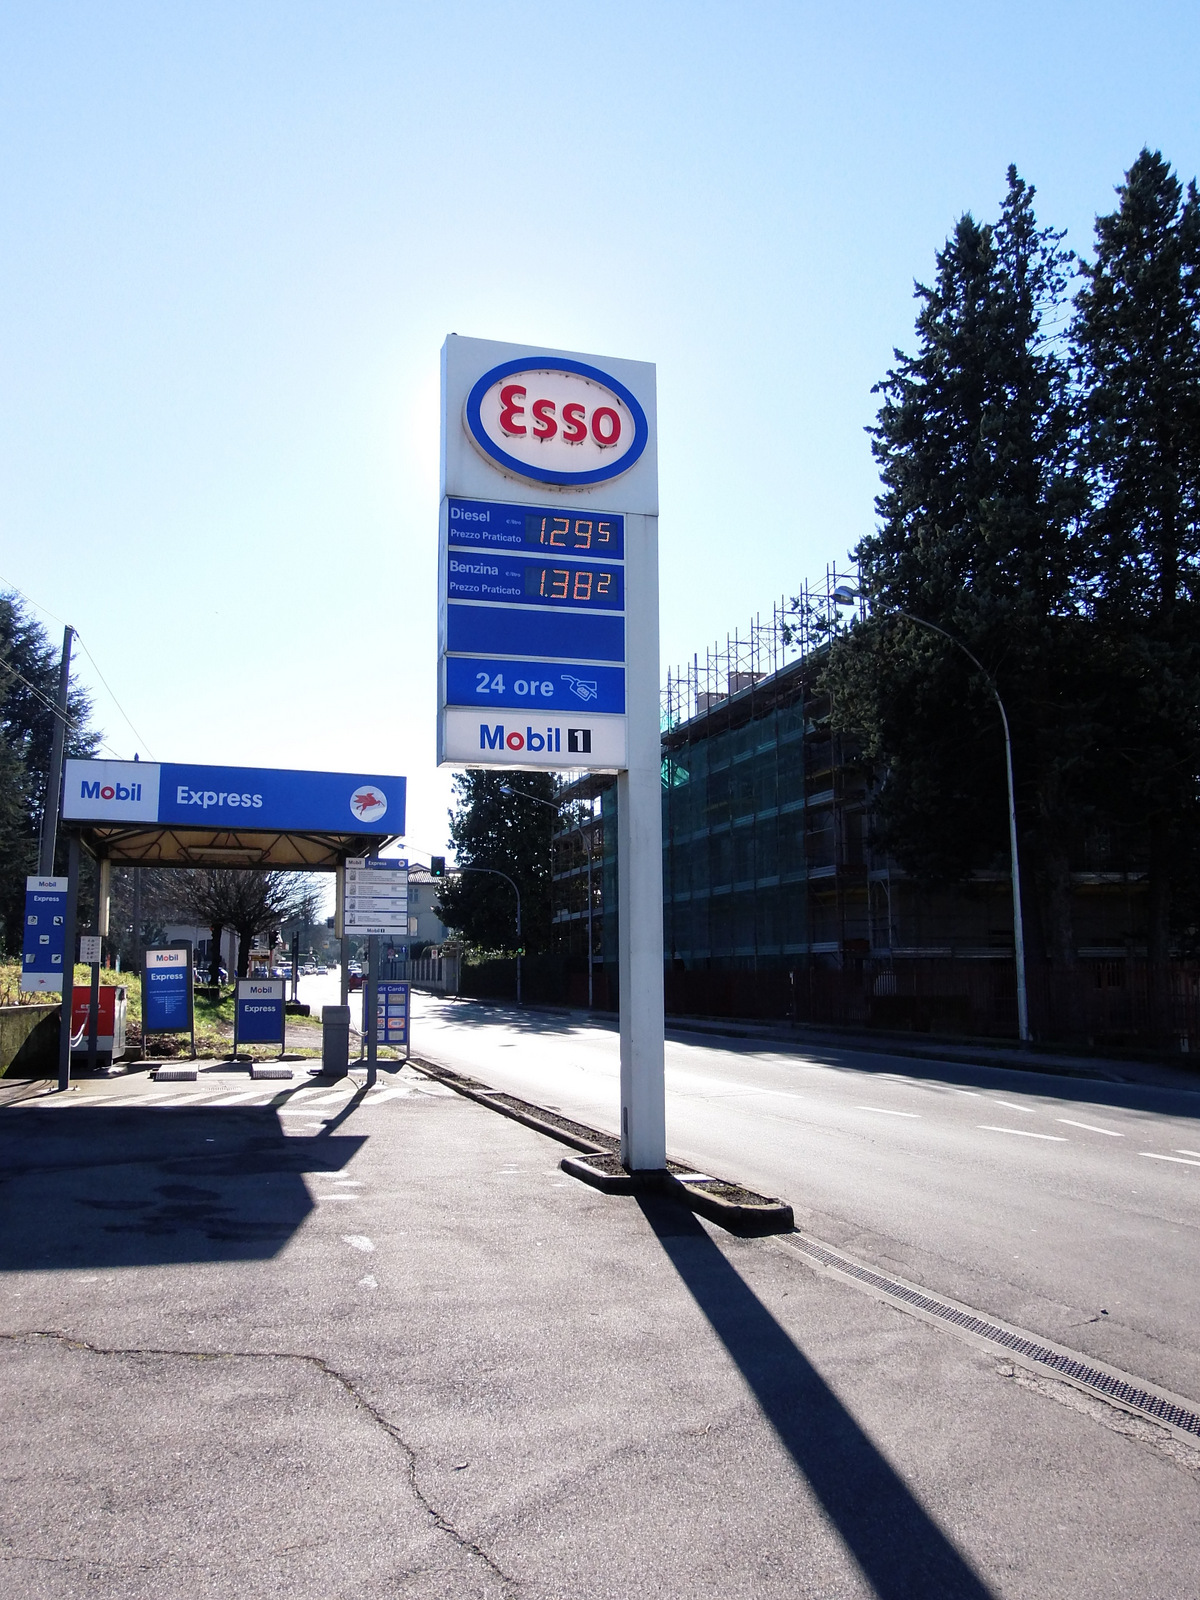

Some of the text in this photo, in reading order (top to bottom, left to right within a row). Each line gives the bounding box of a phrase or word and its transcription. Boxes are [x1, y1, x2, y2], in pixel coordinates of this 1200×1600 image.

[450, 507, 490, 522] Diesel
[450, 528, 522, 543] Prezzo Praticato
[539, 517, 610, 549] 1.295
[449, 560, 499, 576] Benzina
[449, 581, 521, 596] Prezzo Praticato
[539, 569, 611, 601] 1.382
[475, 672, 555, 697] 24 ore
[479, 724, 561, 752] Mobil
[80, 780, 142, 802] Mobil
[176, 786, 263, 809] Express
[33, 895, 60, 903] Express
[156, 954, 179, 962] Mobil
[151, 973, 184, 982] Express
[250, 986, 273, 994] Mobil
[244, 1004, 276, 1013] Express
